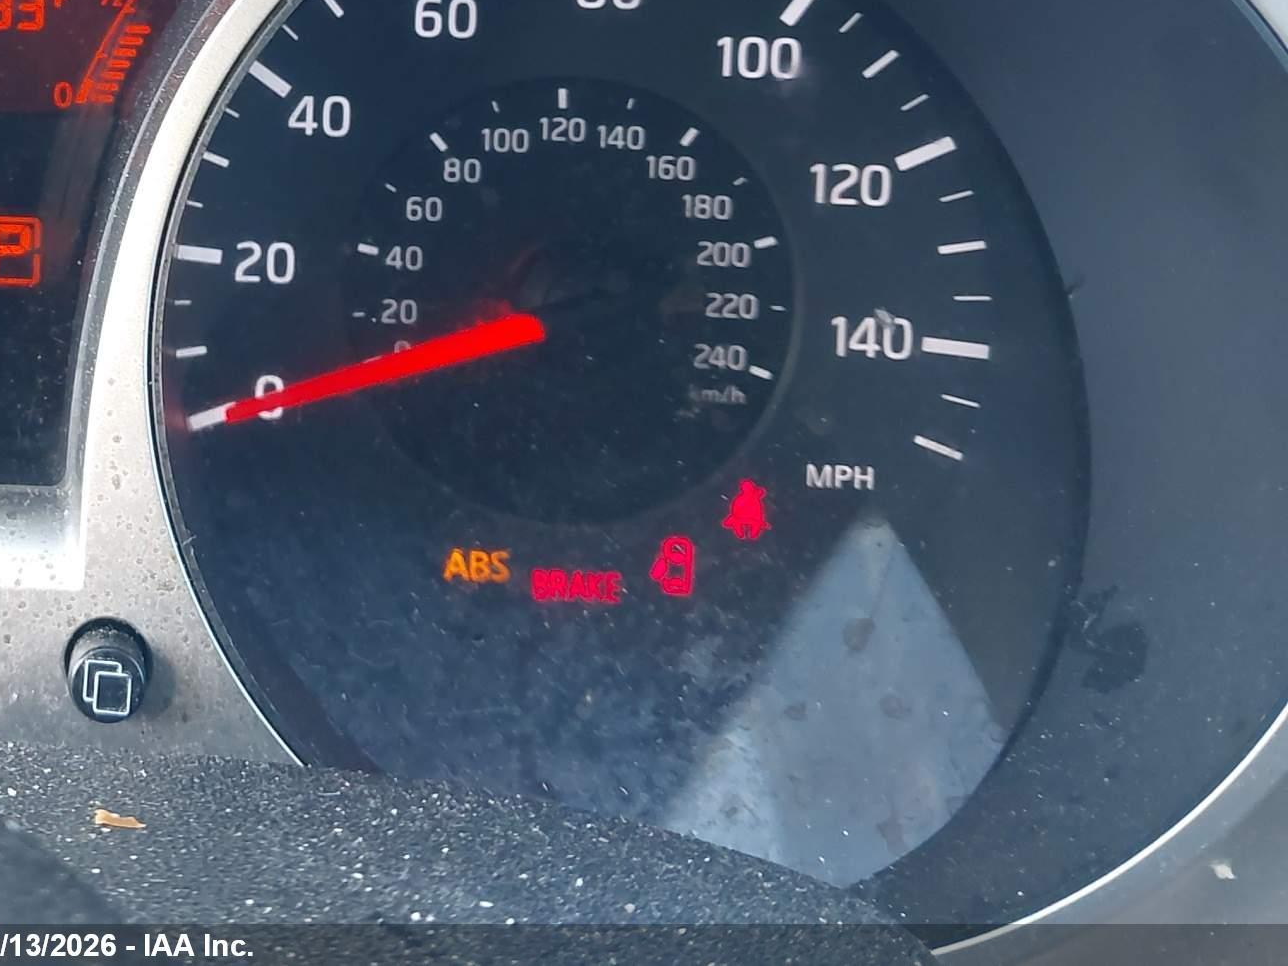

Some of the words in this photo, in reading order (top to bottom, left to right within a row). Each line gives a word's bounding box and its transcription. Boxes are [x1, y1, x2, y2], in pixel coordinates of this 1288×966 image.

[717, 36, 801, 80] 100
[53, 81, 73, 108] 0
[288, 95, 351, 138] 40
[539, 116, 586, 143] 120
[481, 127, 529, 153] 100
[597, 124, 645, 151] 140
[443, 158, 481, 183] 80
[646, 154, 696, 181] 160
[810, 163, 891, 208] 120
[405, 196, 442, 222] 60
[682, 193, 732, 221] 180
[234, 242, 295, 284] 20
[385, 247, 423, 272] 40
[697, 241, 749, 268] 200
[381, 298, 417, 324] 20
[705, 293, 758, 320] 220
[831, 316, 913, 360] 140
[693, 343, 747, 371] 240
[255, 374, 284, 420] 0
[806, 464, 875, 490] MPH
[443, 548, 510, 582] ABS
[531, 569, 623, 604] BRAKE
